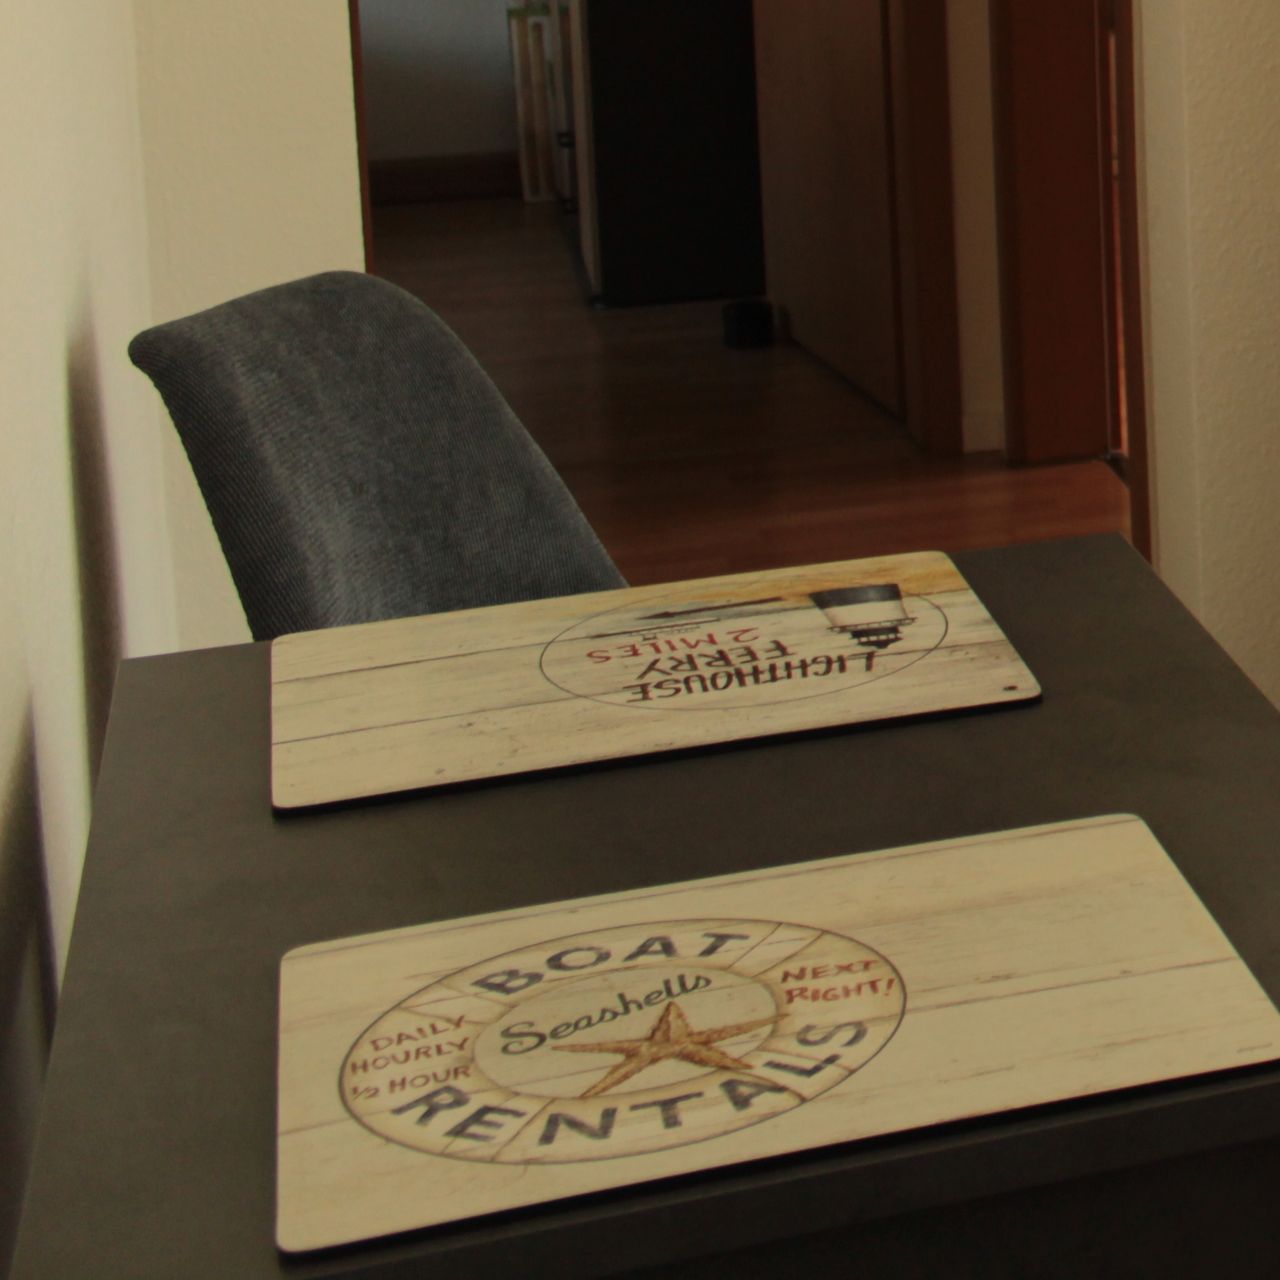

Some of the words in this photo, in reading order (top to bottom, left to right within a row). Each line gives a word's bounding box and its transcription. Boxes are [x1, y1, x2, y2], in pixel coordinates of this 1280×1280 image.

[586, 632, 719, 664] MILES
[726, 626, 760, 643] 2
[621, 650, 877, 703] LIGHTHOUSE
[636, 639, 797, 680] FERRY
[470, 932, 750, 995] BOAT
[781, 959, 880, 984] NEXT
[784, 977, 896, 1004] RIGHT!
[369, 1014, 466, 1052] DAILY
[500, 973, 712, 1055] Seashells
[350, 1036, 470, 1075] HOURLY
[388, 1064, 472, 1094] HOUR
[389, 1021, 868, 1146] RENTALS
